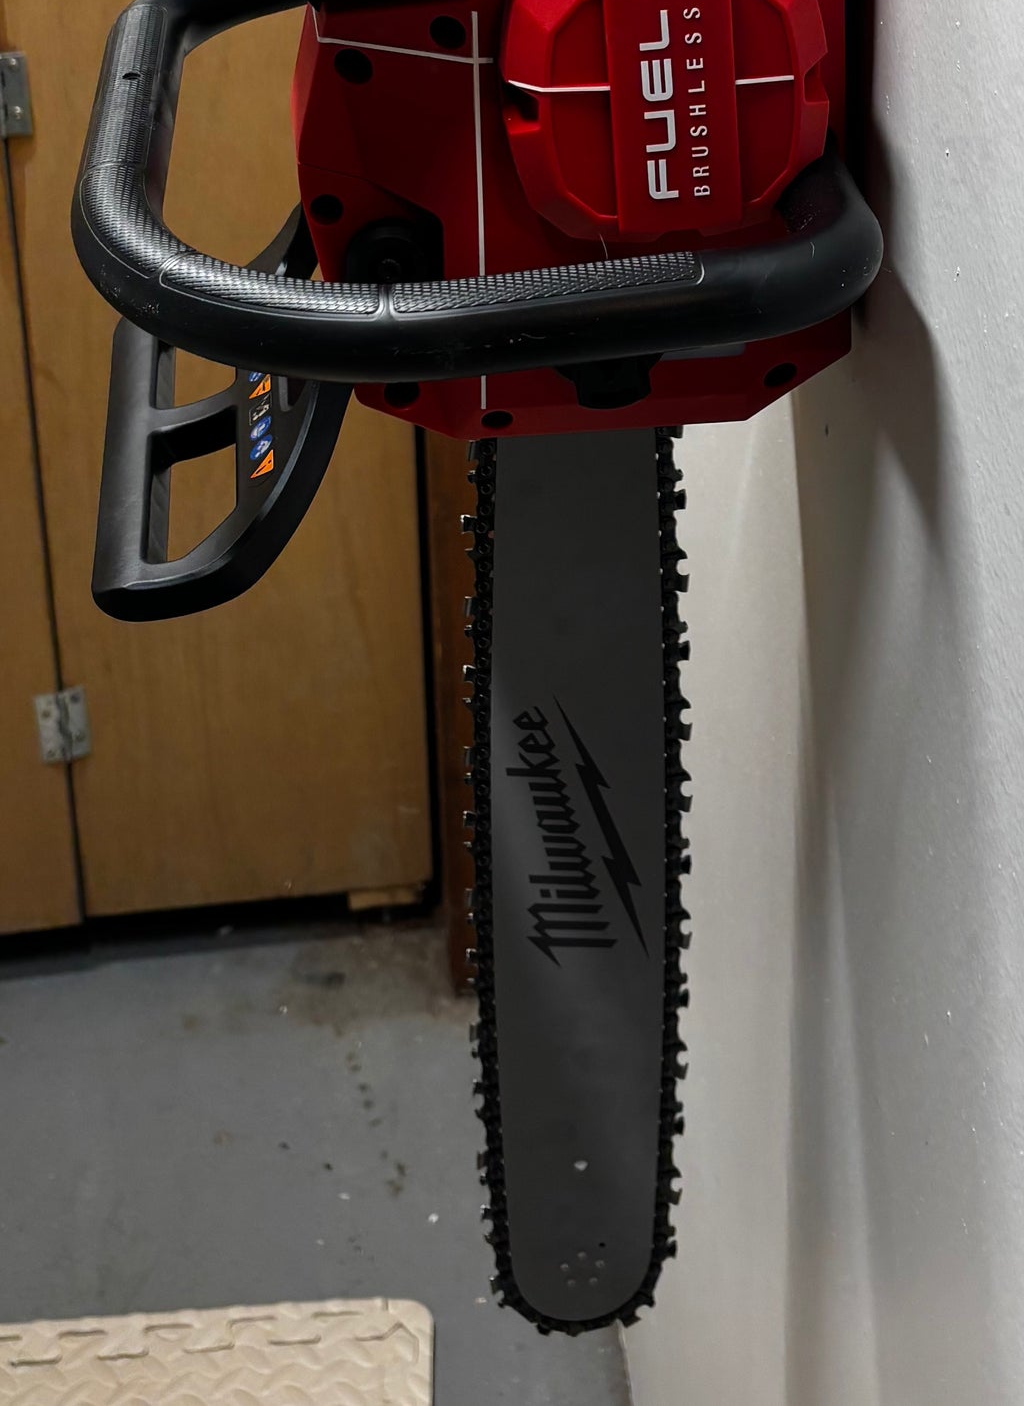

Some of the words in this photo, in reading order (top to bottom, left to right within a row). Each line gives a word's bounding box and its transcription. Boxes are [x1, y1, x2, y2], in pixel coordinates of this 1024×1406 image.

[639, 9, 680, 200] FUEL
[683, 7, 711, 197] BRUSHLESS
[505, 705, 618, 969] Milwaukee
